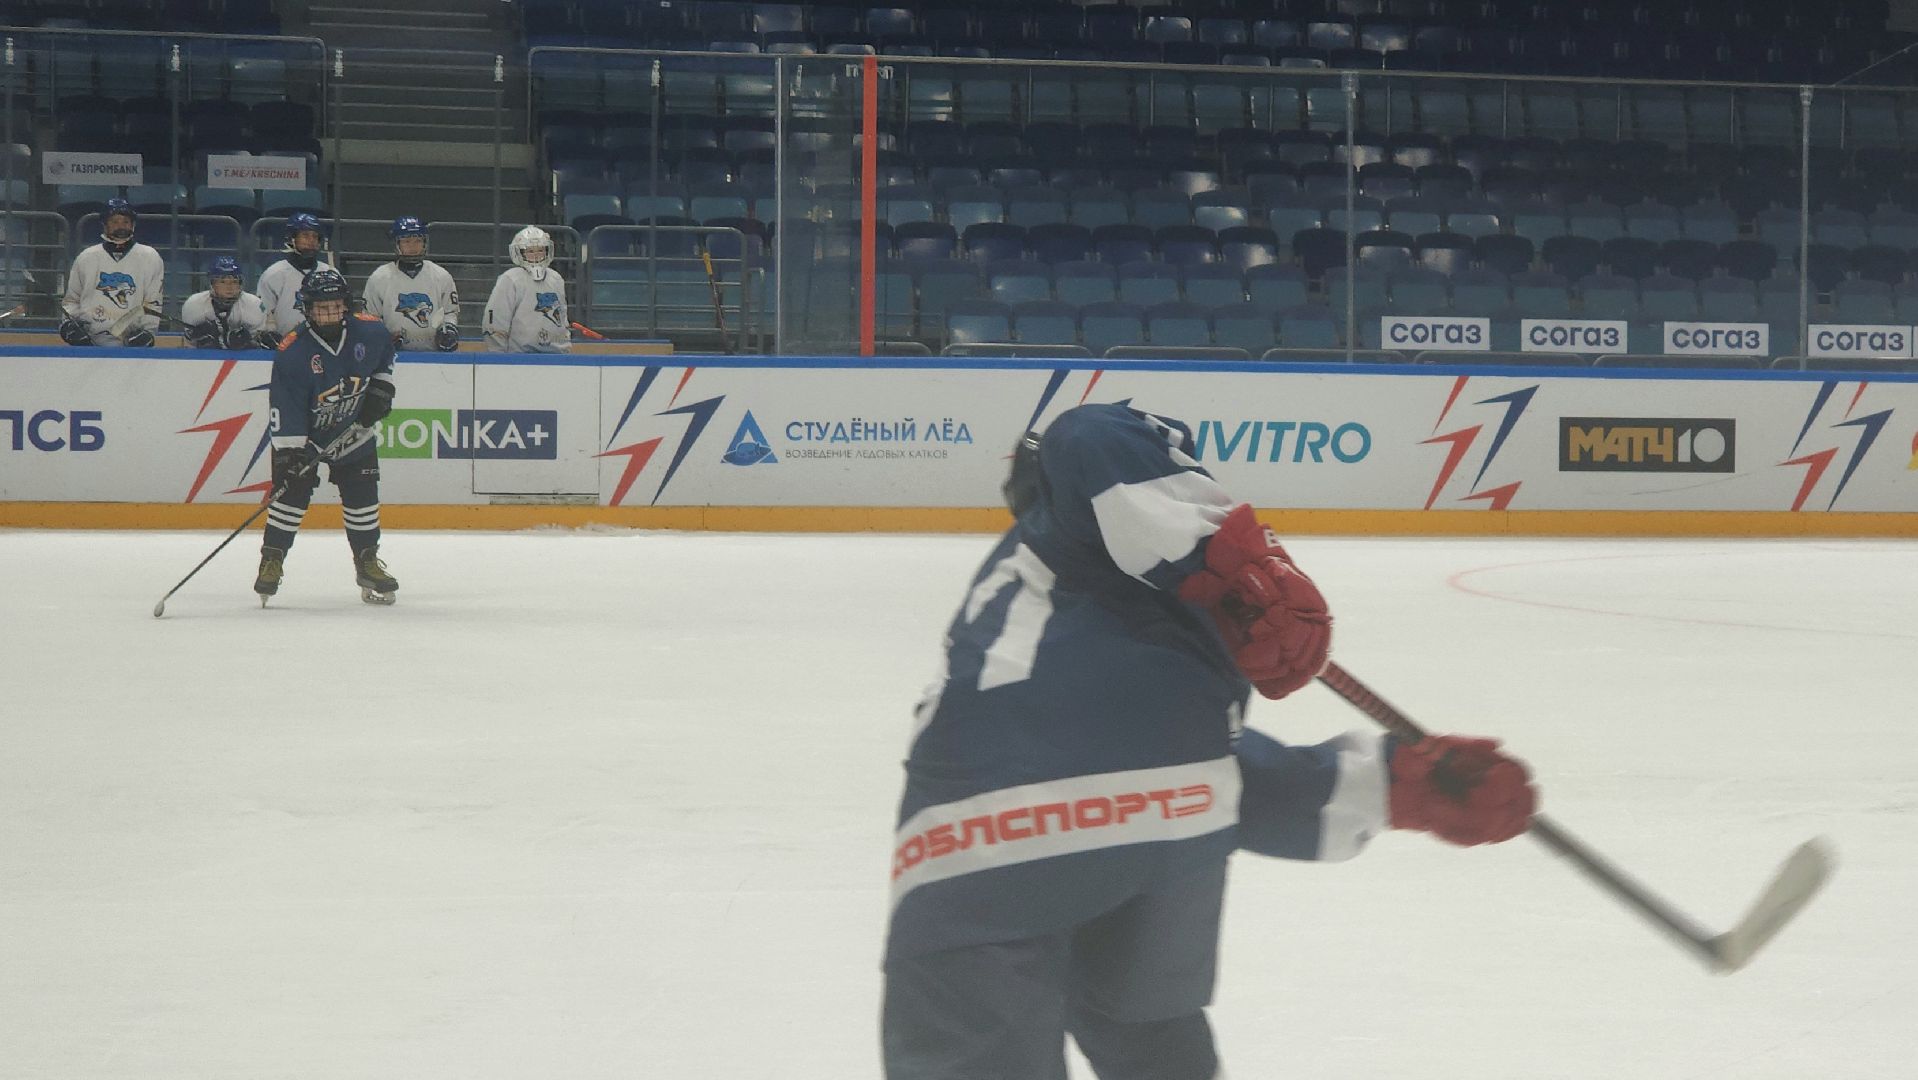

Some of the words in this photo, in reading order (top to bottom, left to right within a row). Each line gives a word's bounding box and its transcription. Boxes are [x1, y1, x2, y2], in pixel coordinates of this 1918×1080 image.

[71, 163, 138, 175] ГАЗПРОМБАНК
[785, 417, 916, 444] СТУДЁНЫЙ
[924, 417, 973, 445] ЛЁД
[785, 449, 852, 459] ВОЗВЕДЕНИЕ
[855, 449, 906, 459] ЛЕДОВЫХ
[909, 449, 948, 459] КАТКОВ
